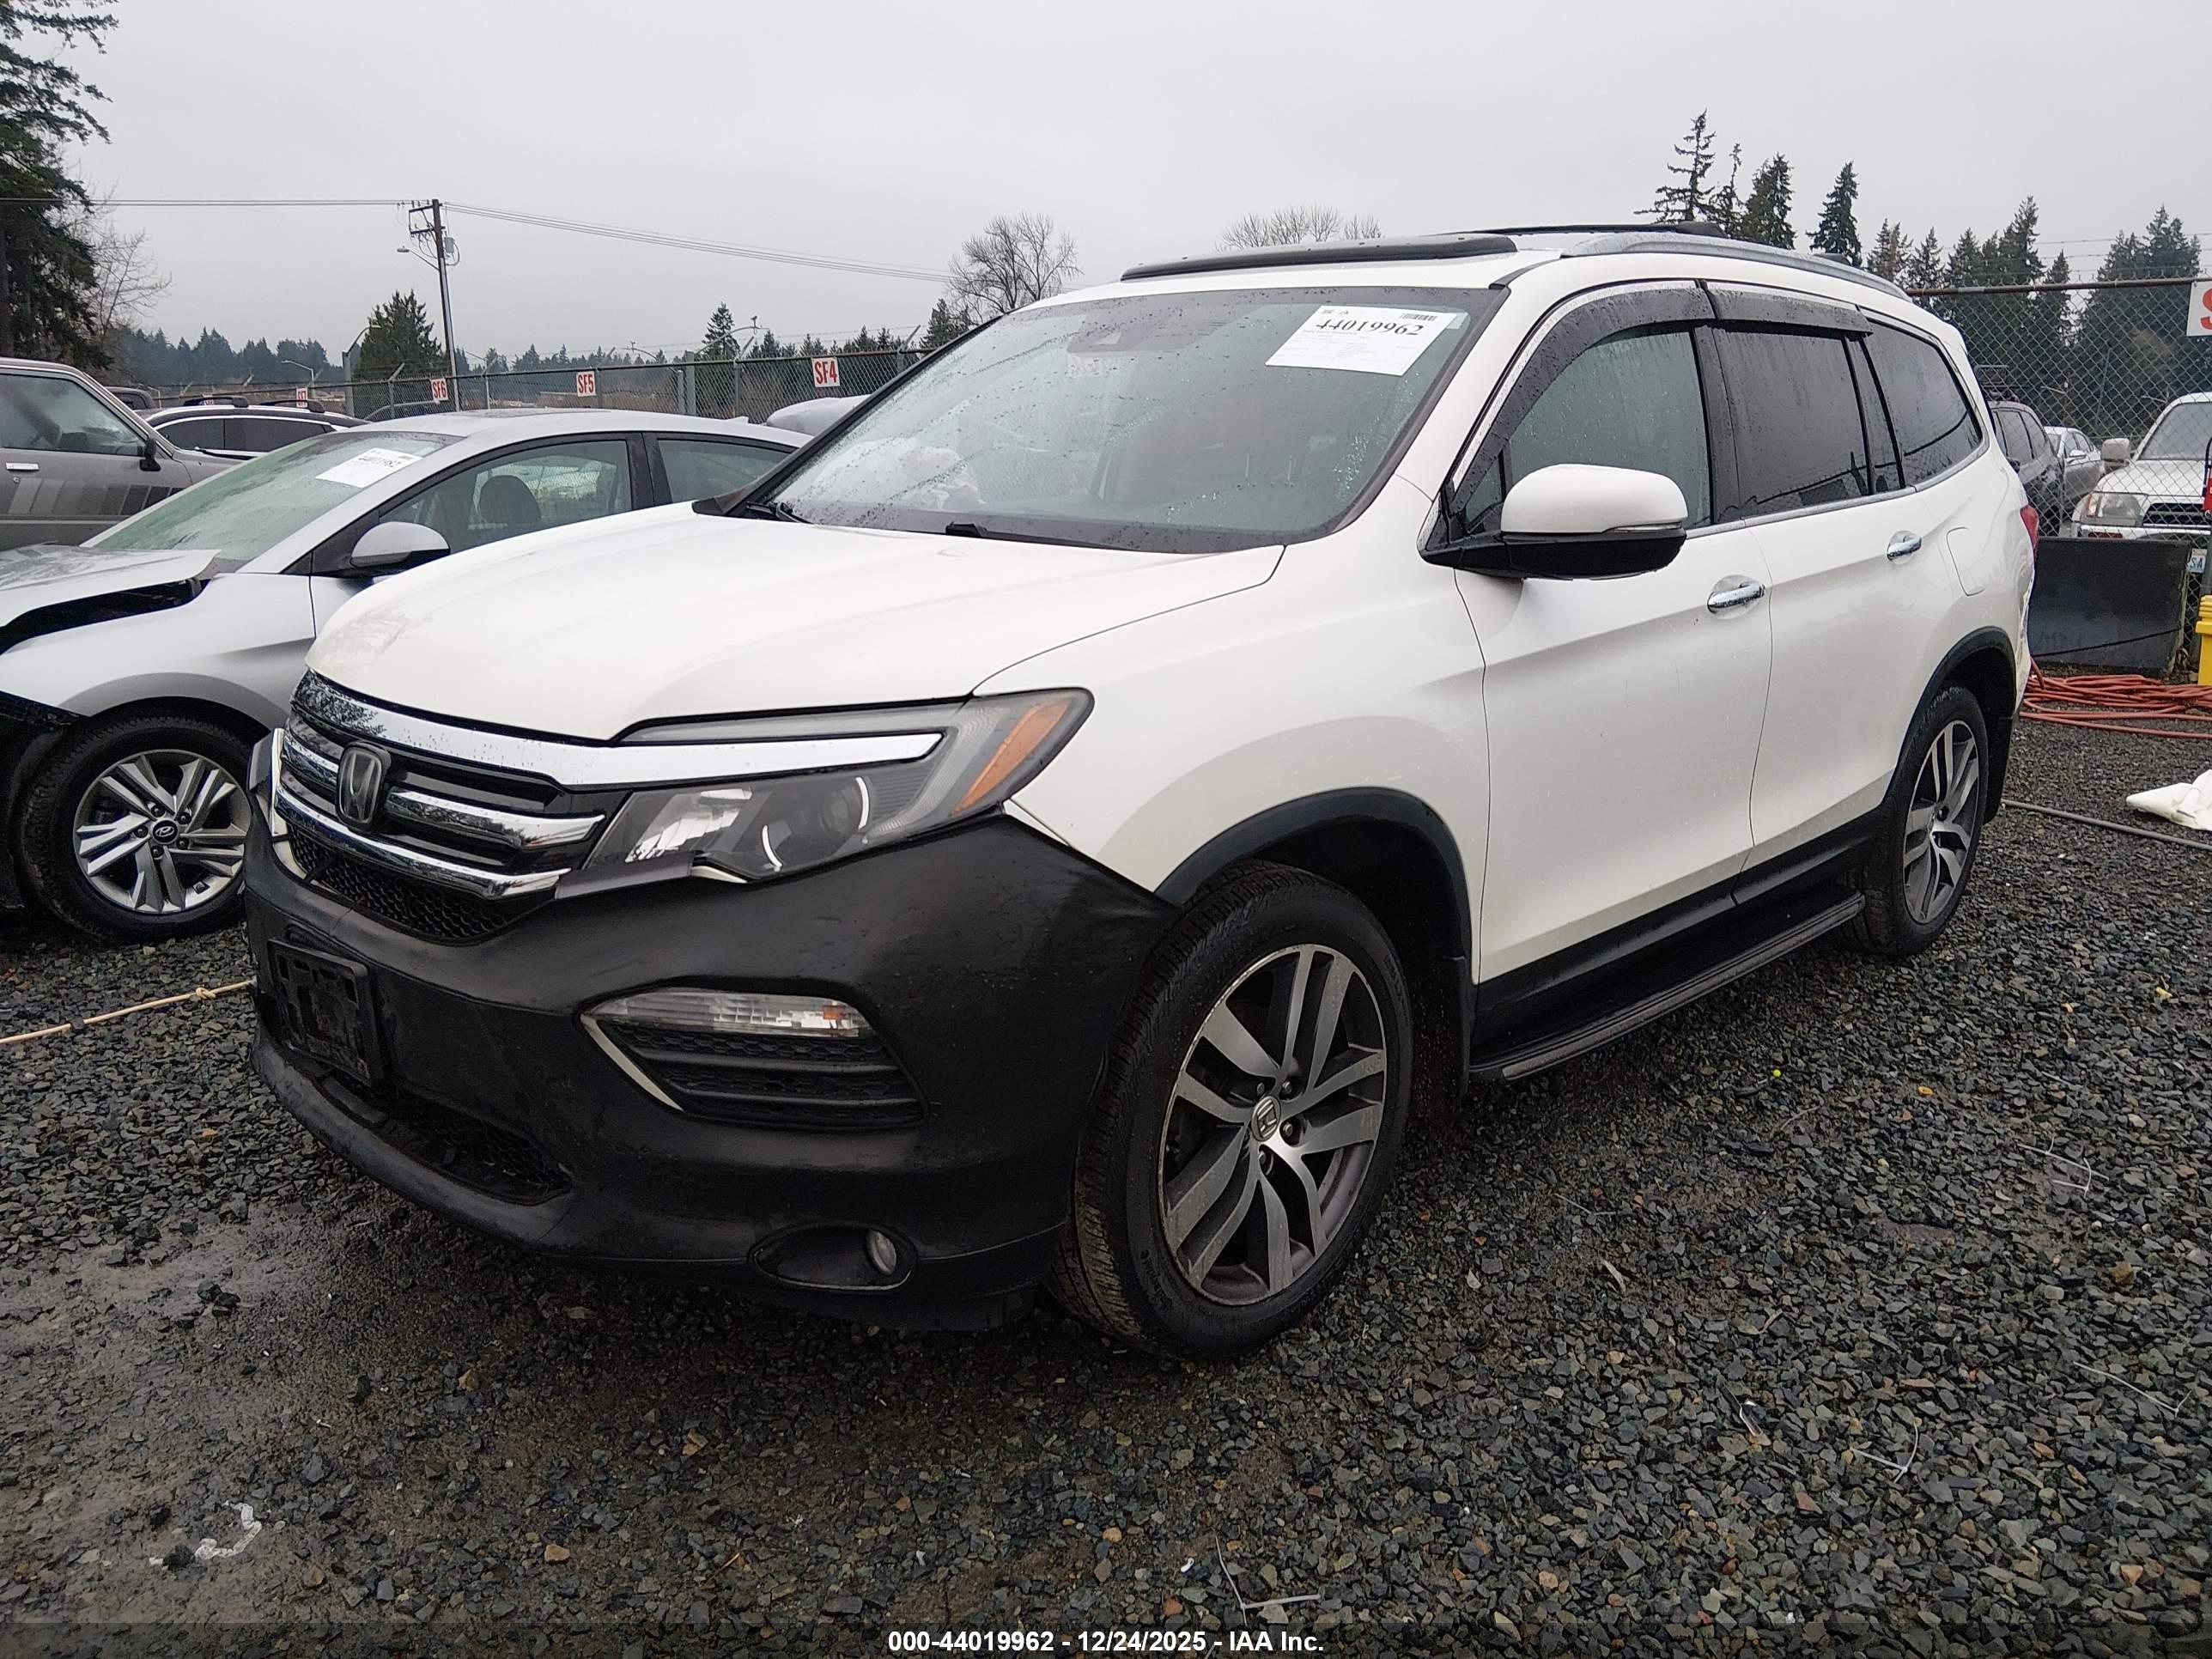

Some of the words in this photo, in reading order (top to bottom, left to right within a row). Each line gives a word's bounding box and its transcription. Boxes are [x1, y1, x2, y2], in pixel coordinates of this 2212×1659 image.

[1316, 319, 1425, 336] 44019962
[815, 361, 837, 384] SF4
[433, 379, 447, 398] SF6
[578, 374, 594, 393] SF5
